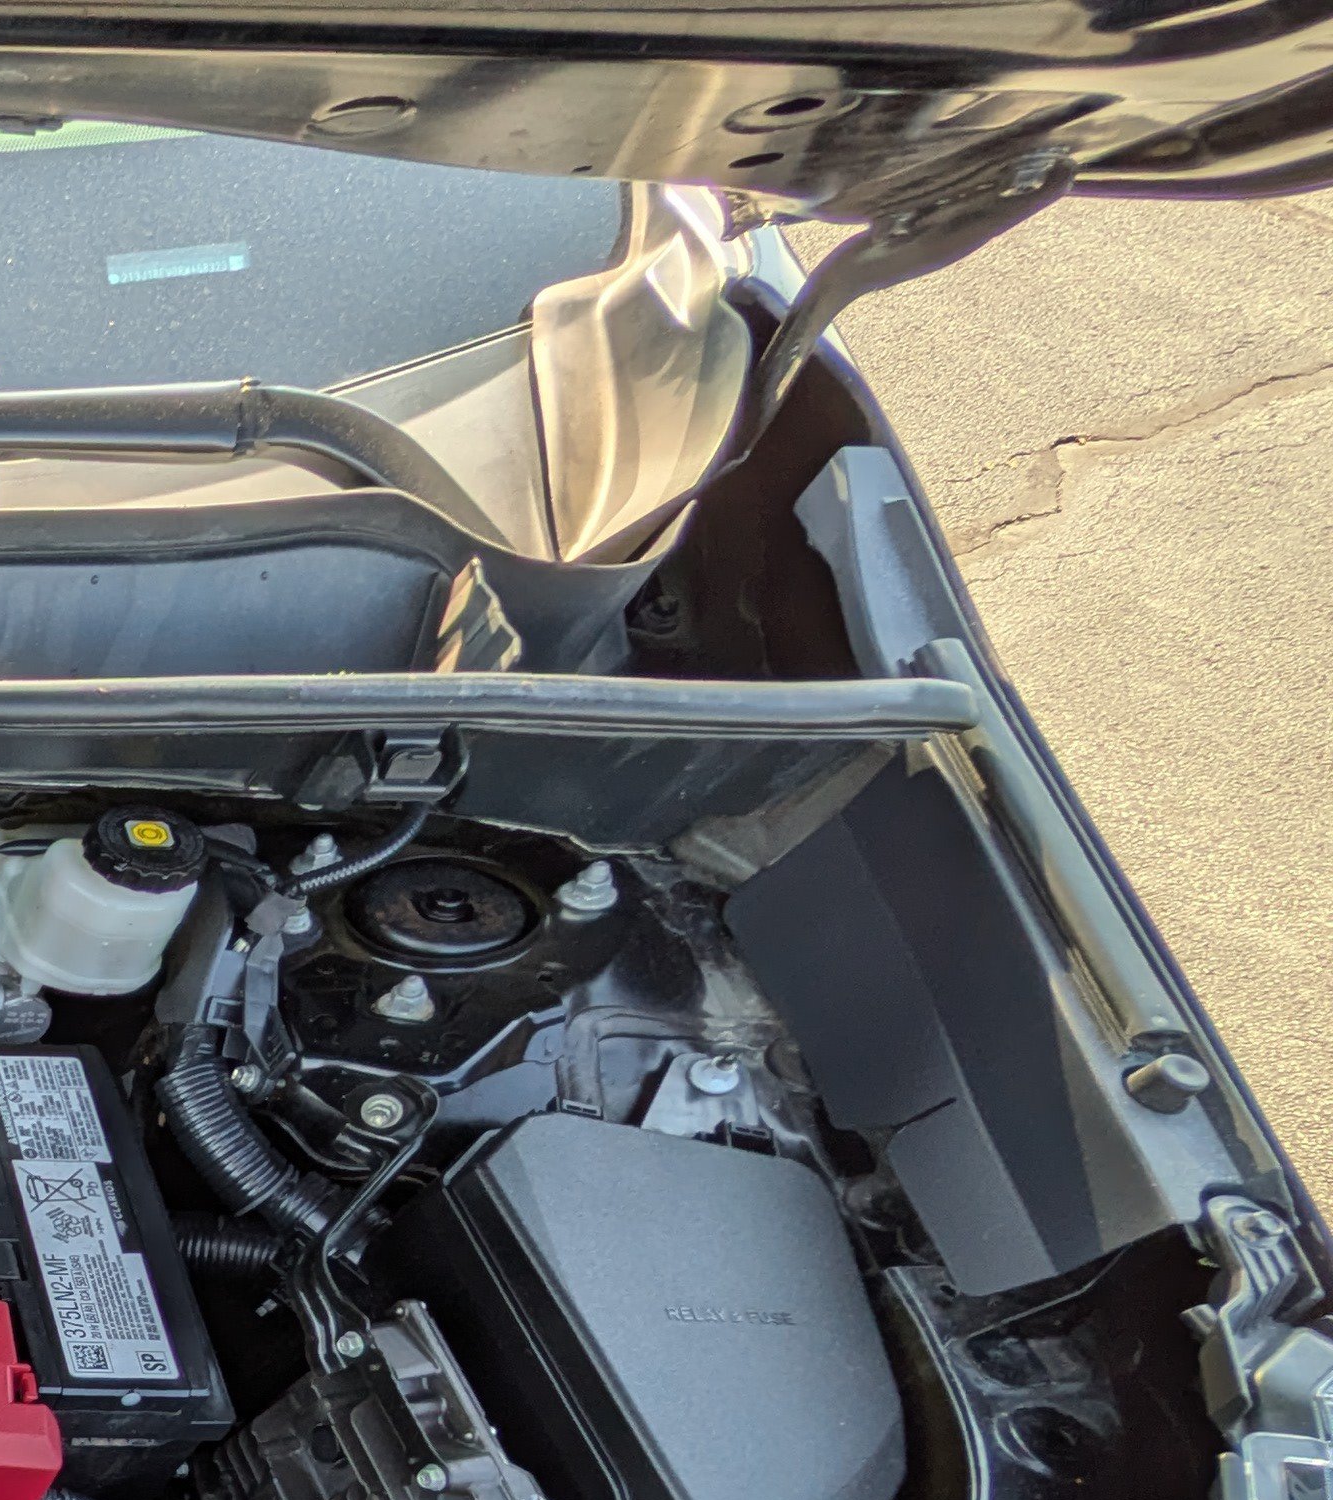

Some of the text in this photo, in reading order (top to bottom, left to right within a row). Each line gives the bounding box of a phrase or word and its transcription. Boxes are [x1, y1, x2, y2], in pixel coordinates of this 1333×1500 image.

[87, 1181, 101, 1197] Pb
[103, 1180, 123, 1219] CLARIOS
[42, 1253, 87, 1338] 375LN2-MF
[664, 1306, 726, 1322] RELAY
[746, 1311, 797, 1326] FUSE
[141, 1353, 167, 1371] SP
